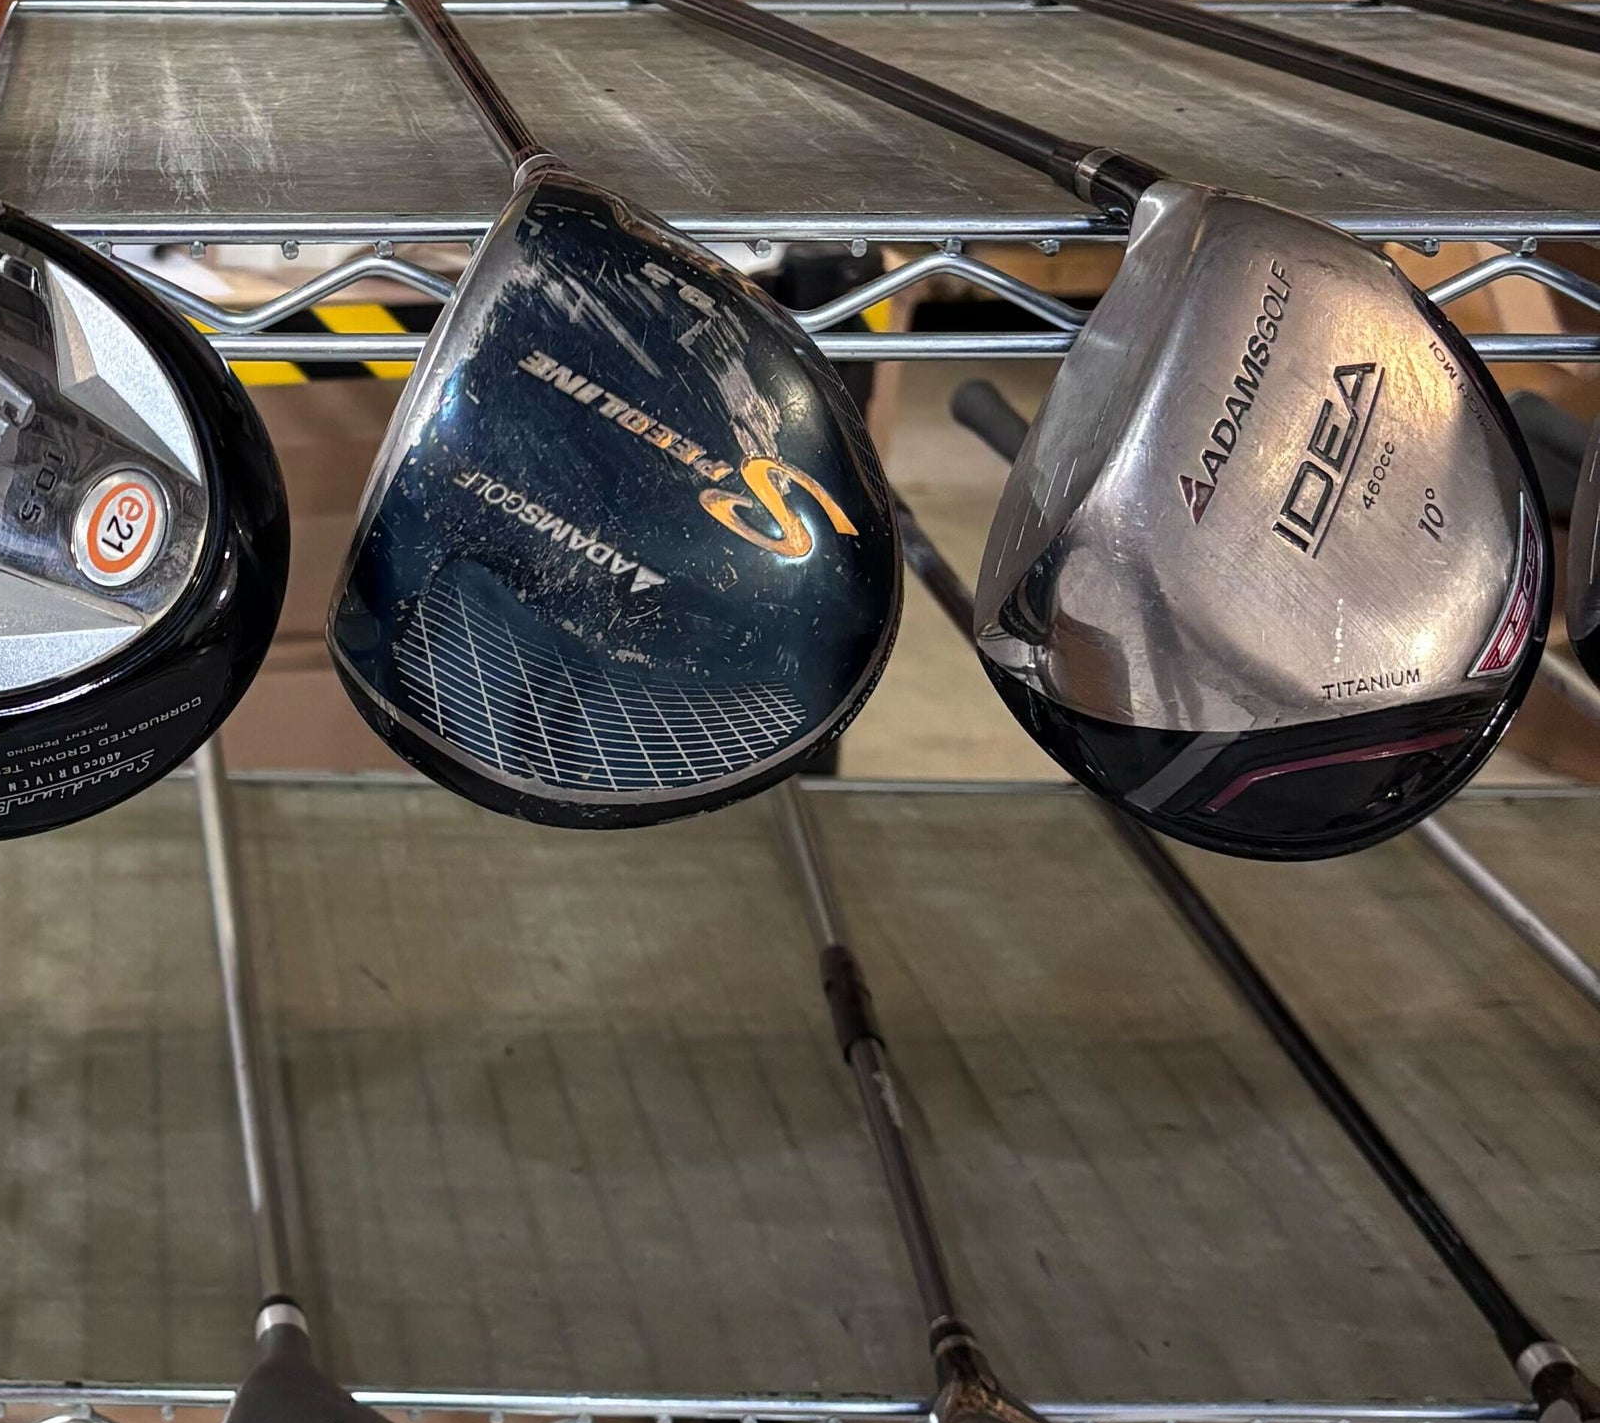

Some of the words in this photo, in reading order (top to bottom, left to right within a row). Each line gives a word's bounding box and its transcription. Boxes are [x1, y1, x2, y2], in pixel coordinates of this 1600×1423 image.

[1202, 258, 1297, 485] ADAMSGOLF
[16, 443, 69, 524] 10.5
[1270, 359, 1379, 553] IDEA
[1361, 440, 1397, 512] 460cc
[99, 489, 146, 559] e21
[452, 467, 642, 577] ADAMSGOLF
[1321, 666, 1422, 702] TITANIUM
[6, 738, 59, 757] PENDING
[65, 722, 109, 742] PATENT
[108, 696, 202, 748] CORRUGATED
[8, 750, 156, 809] Scandium
[28, 746, 93, 770] CROWN
[83, 751, 122, 770] 460cc
